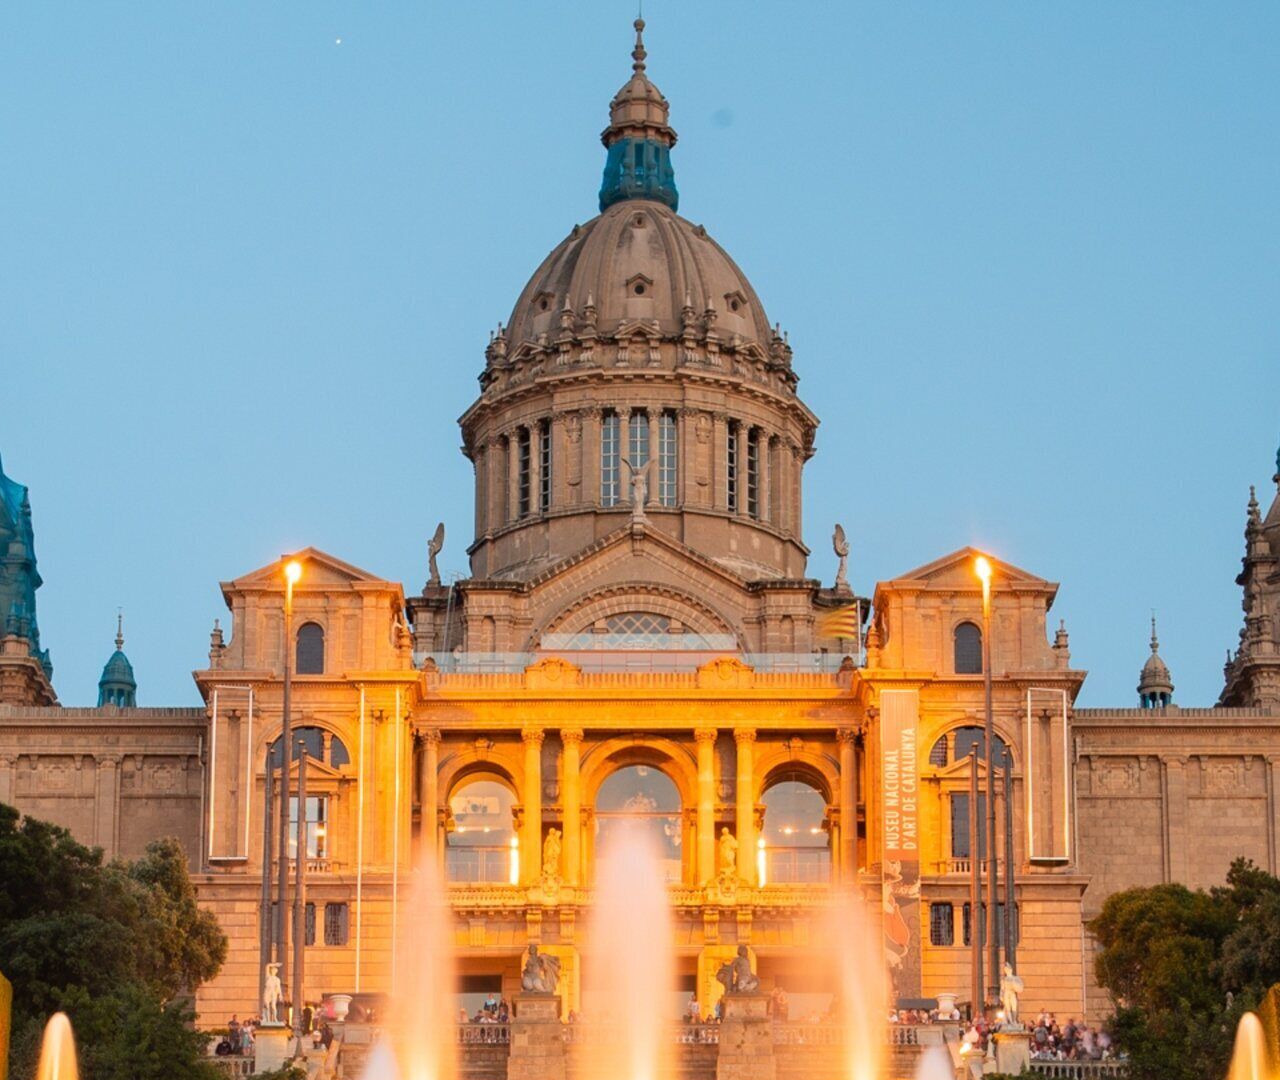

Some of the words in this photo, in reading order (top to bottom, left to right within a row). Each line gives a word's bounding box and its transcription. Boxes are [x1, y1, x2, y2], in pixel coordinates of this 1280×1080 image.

[885, 749, 900, 806] NACIONAL
[901, 728, 916, 793] CATALUNYA
[902, 797, 916, 811] DE
[886, 811, 900, 849] MUSEU
[902, 816, 917, 850] D'ART
